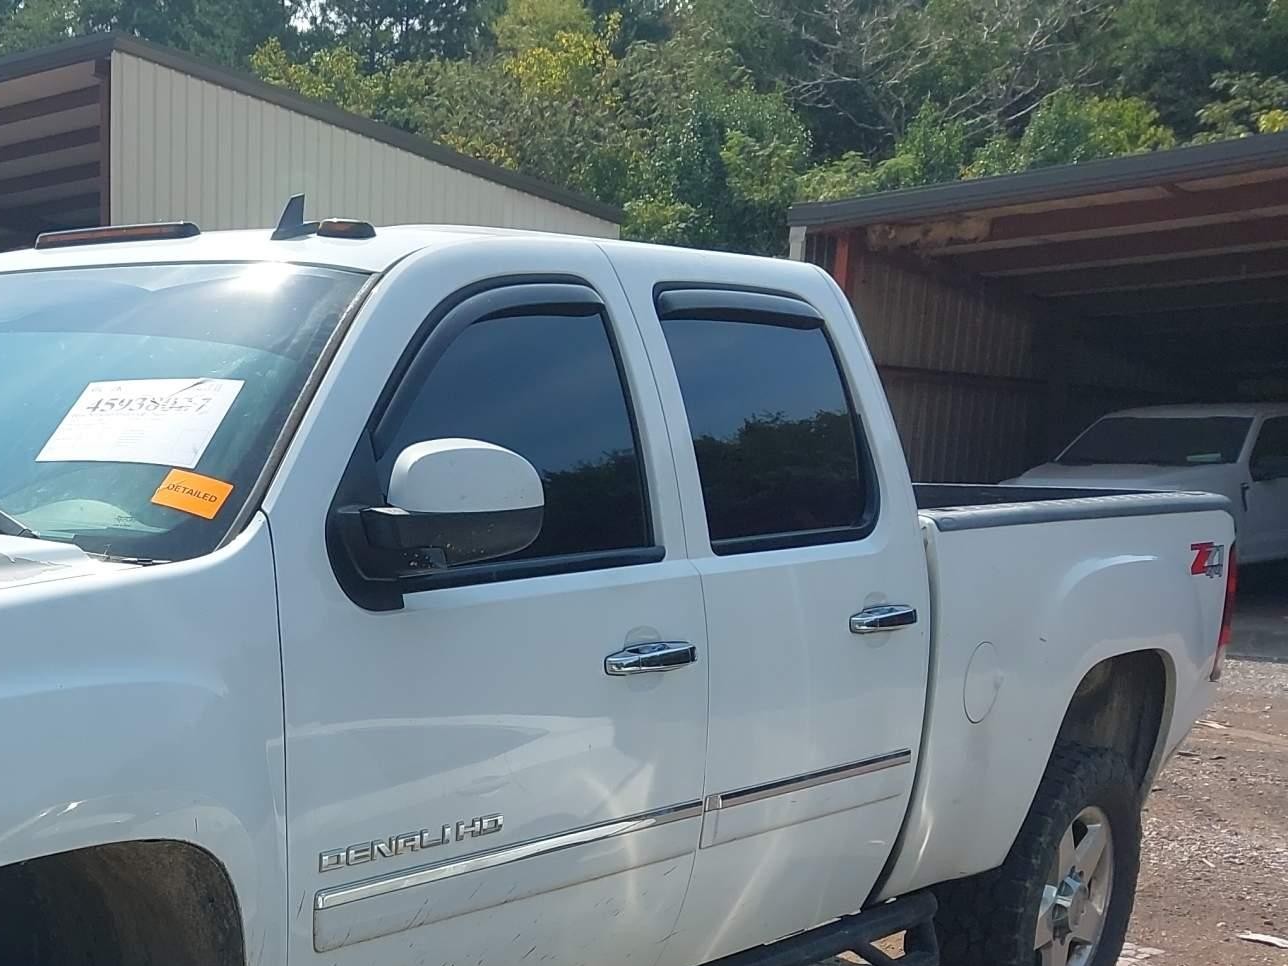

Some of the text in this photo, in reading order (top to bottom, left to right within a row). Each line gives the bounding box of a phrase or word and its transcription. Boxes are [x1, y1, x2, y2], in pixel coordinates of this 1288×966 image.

[167, 483, 218, 503] DETAILED
[319, 812, 504, 872] DENALI HD
